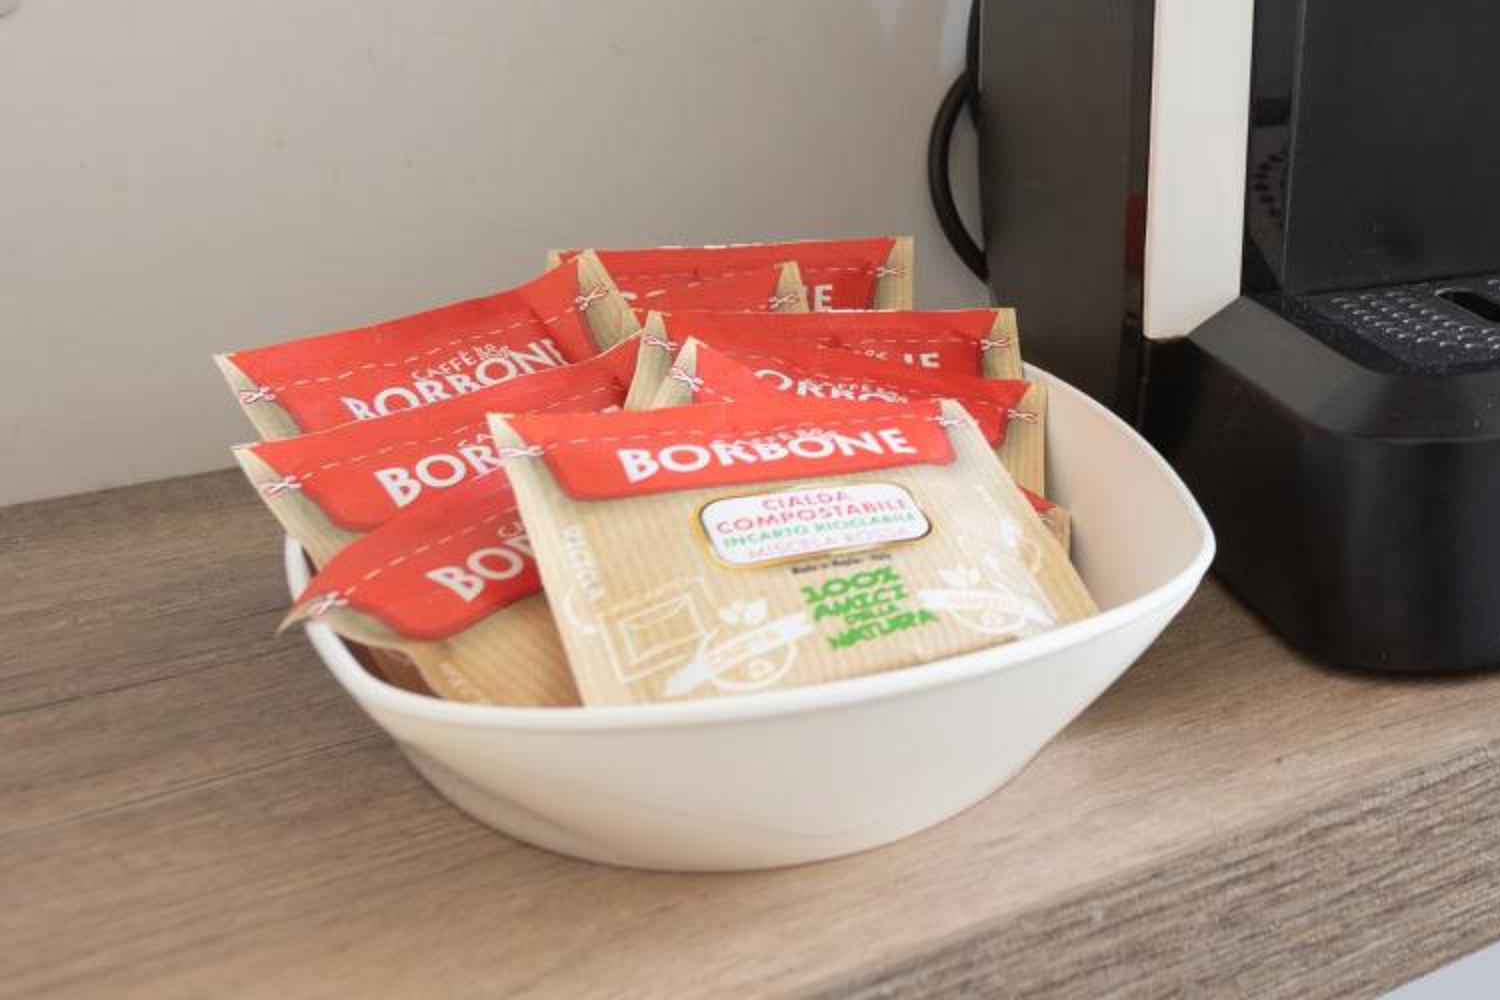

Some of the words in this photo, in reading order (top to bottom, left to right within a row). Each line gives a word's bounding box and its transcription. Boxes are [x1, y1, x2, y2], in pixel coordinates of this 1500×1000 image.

[616, 428, 918, 483] BORBONE
[761, 491, 850, 511] CIALDA
[802, 565, 900, 603] 100%
